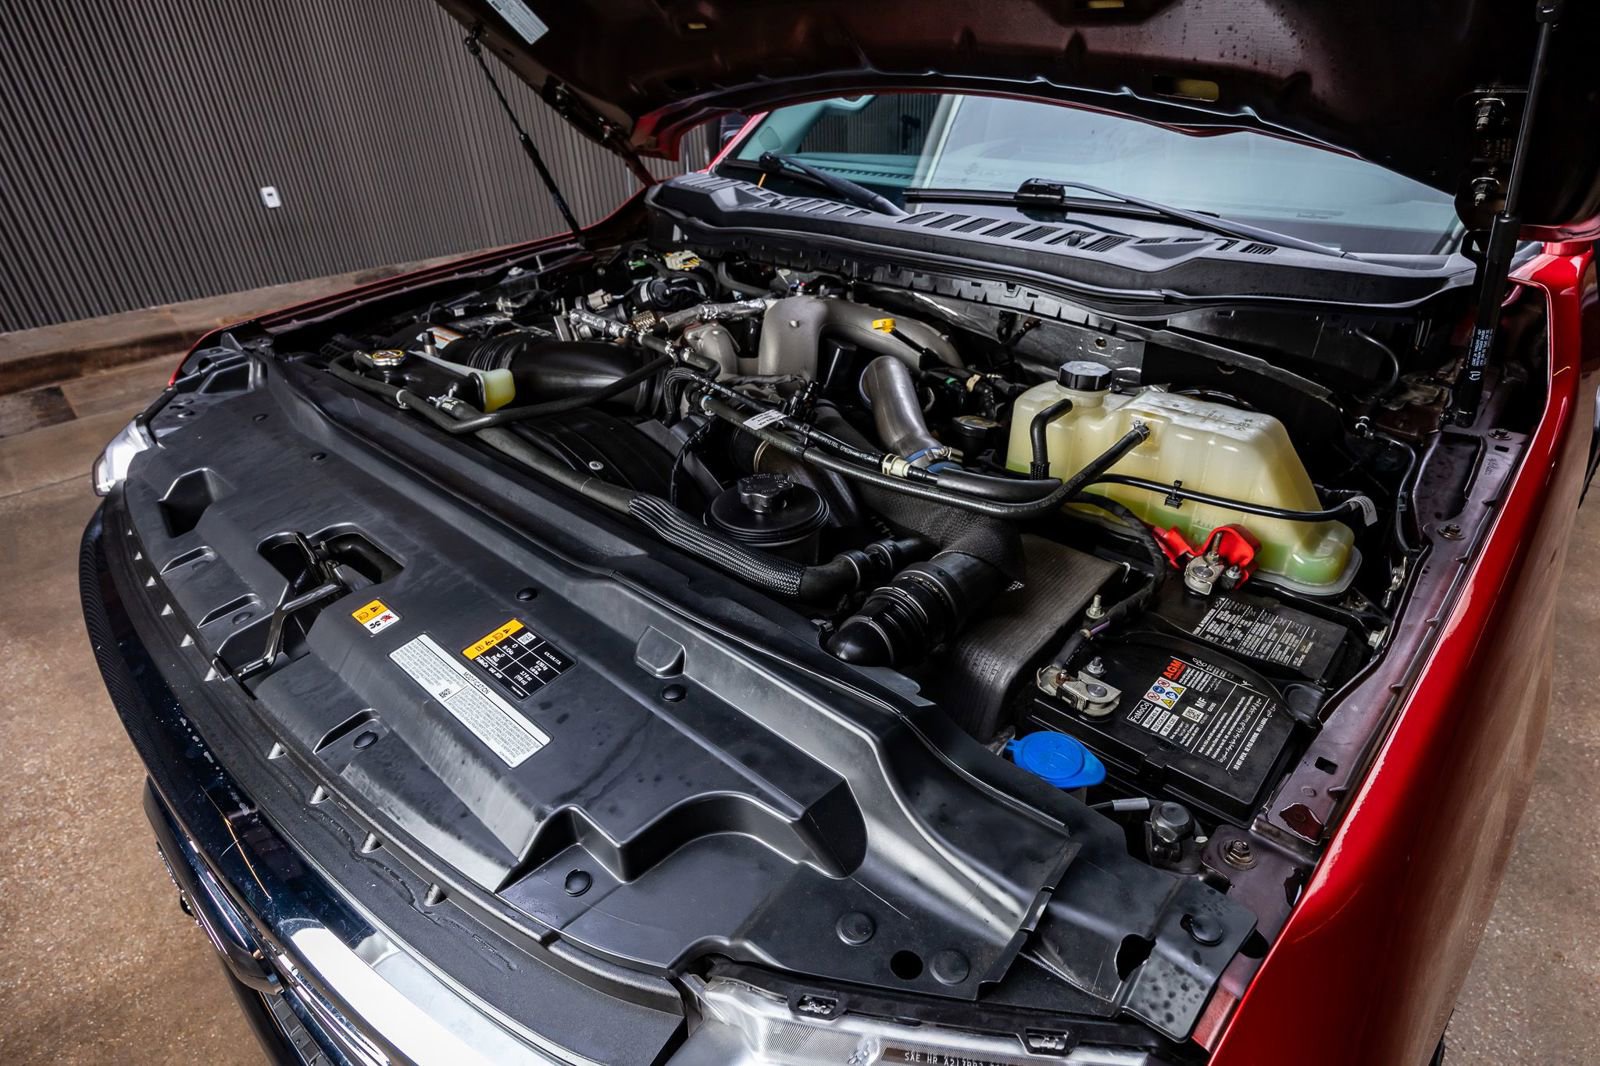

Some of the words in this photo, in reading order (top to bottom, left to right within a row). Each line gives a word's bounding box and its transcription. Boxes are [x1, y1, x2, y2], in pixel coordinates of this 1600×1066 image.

[1161, 658, 1183, 679] AGM
[1193, 695, 1209, 709] MF
[904, 1051, 921, 1063] SAE
[926, 1053, 938, 1065] HR
